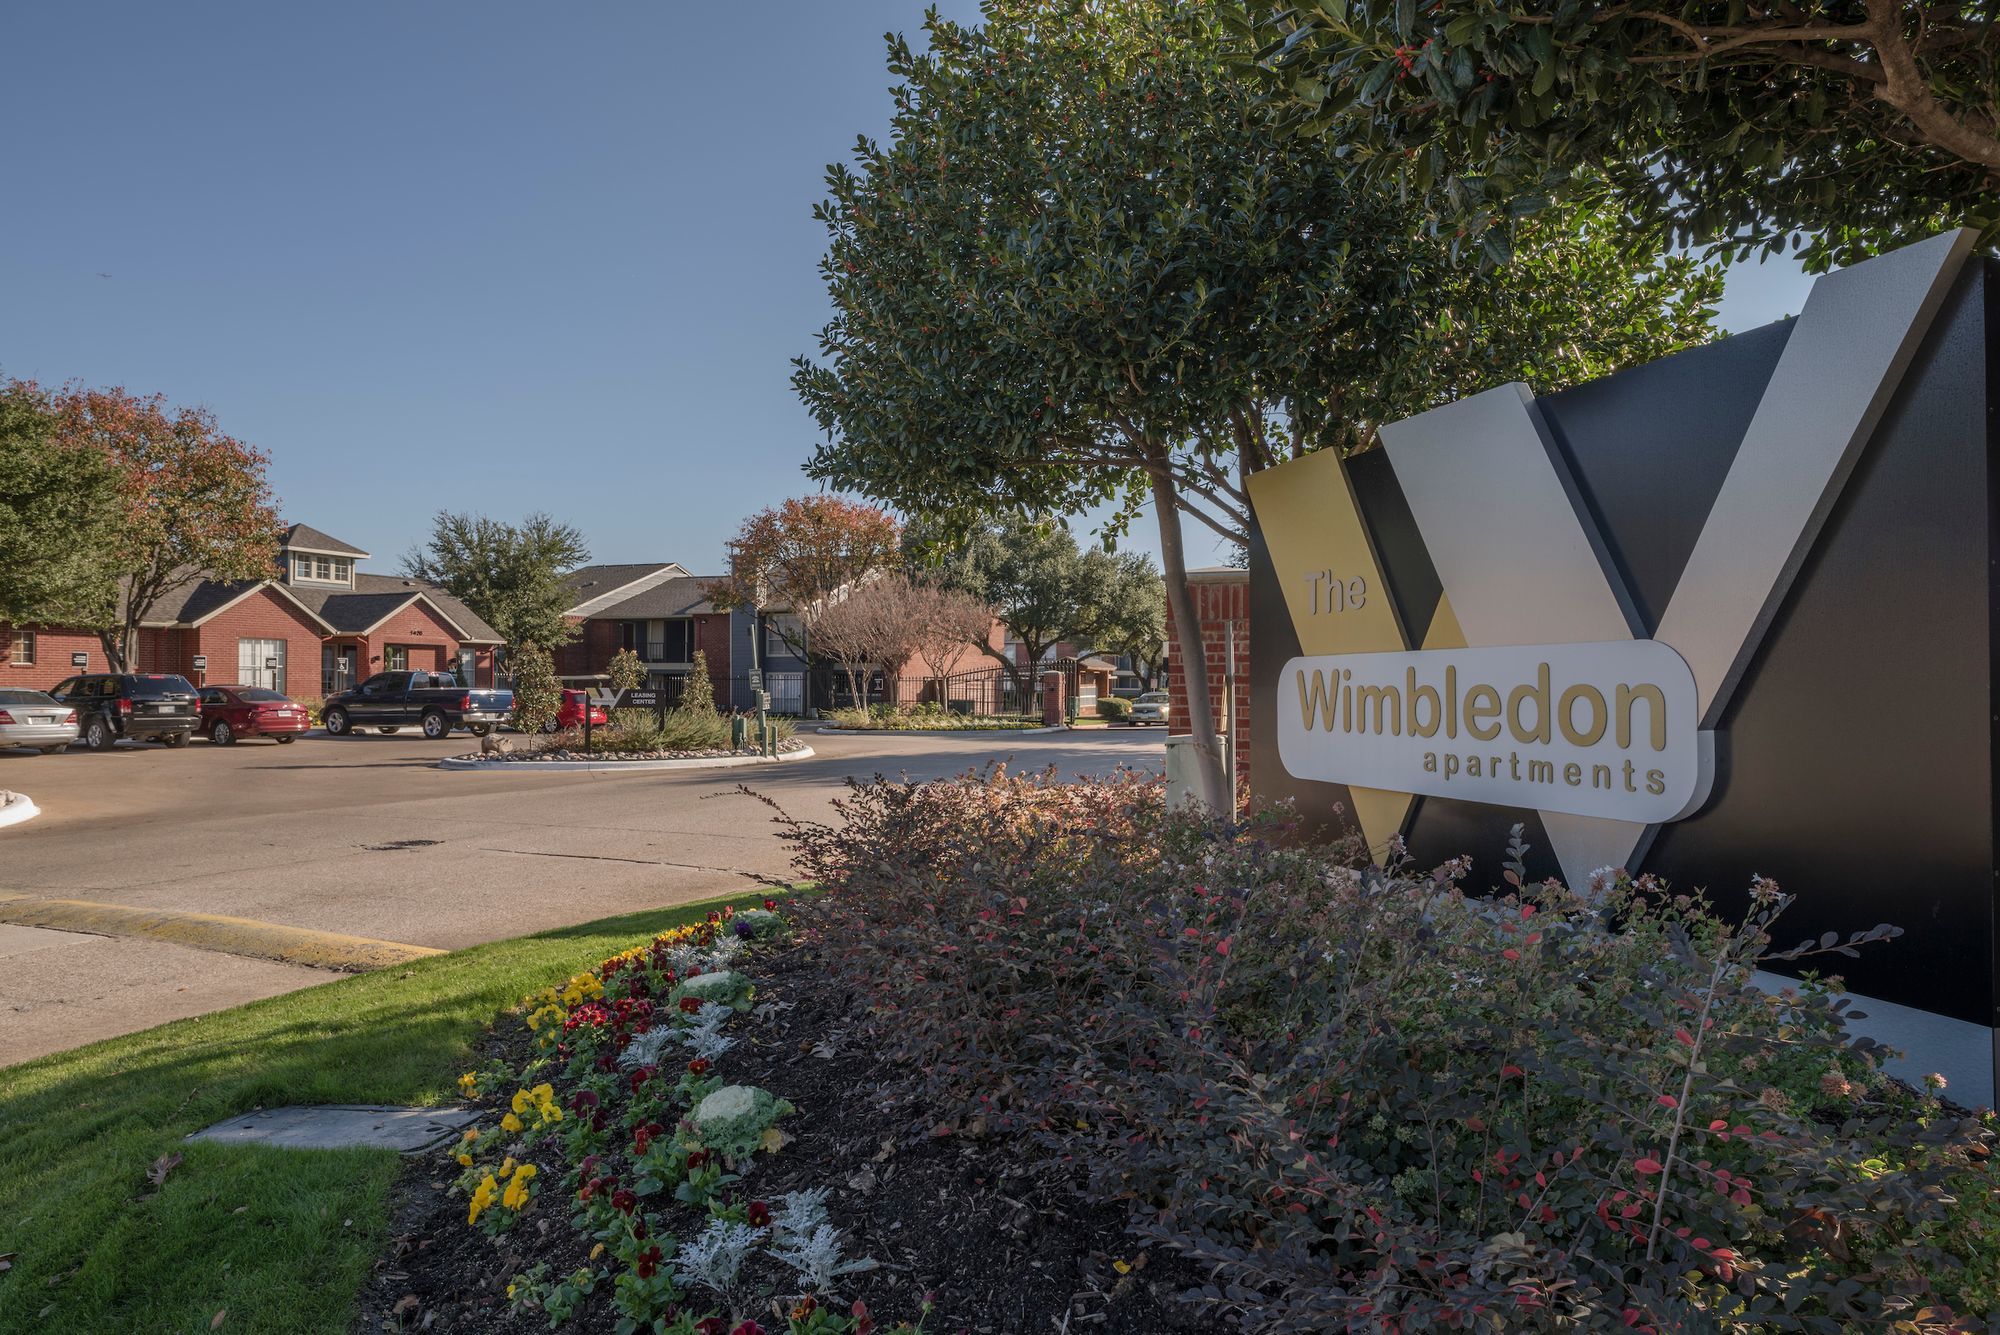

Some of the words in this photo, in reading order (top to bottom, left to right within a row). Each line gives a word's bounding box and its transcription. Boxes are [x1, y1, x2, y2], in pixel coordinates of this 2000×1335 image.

[1305, 569, 1367, 616] The
[1296, 661, 1668, 752] Wimbledon
[1423, 751, 1668, 796] apartments
